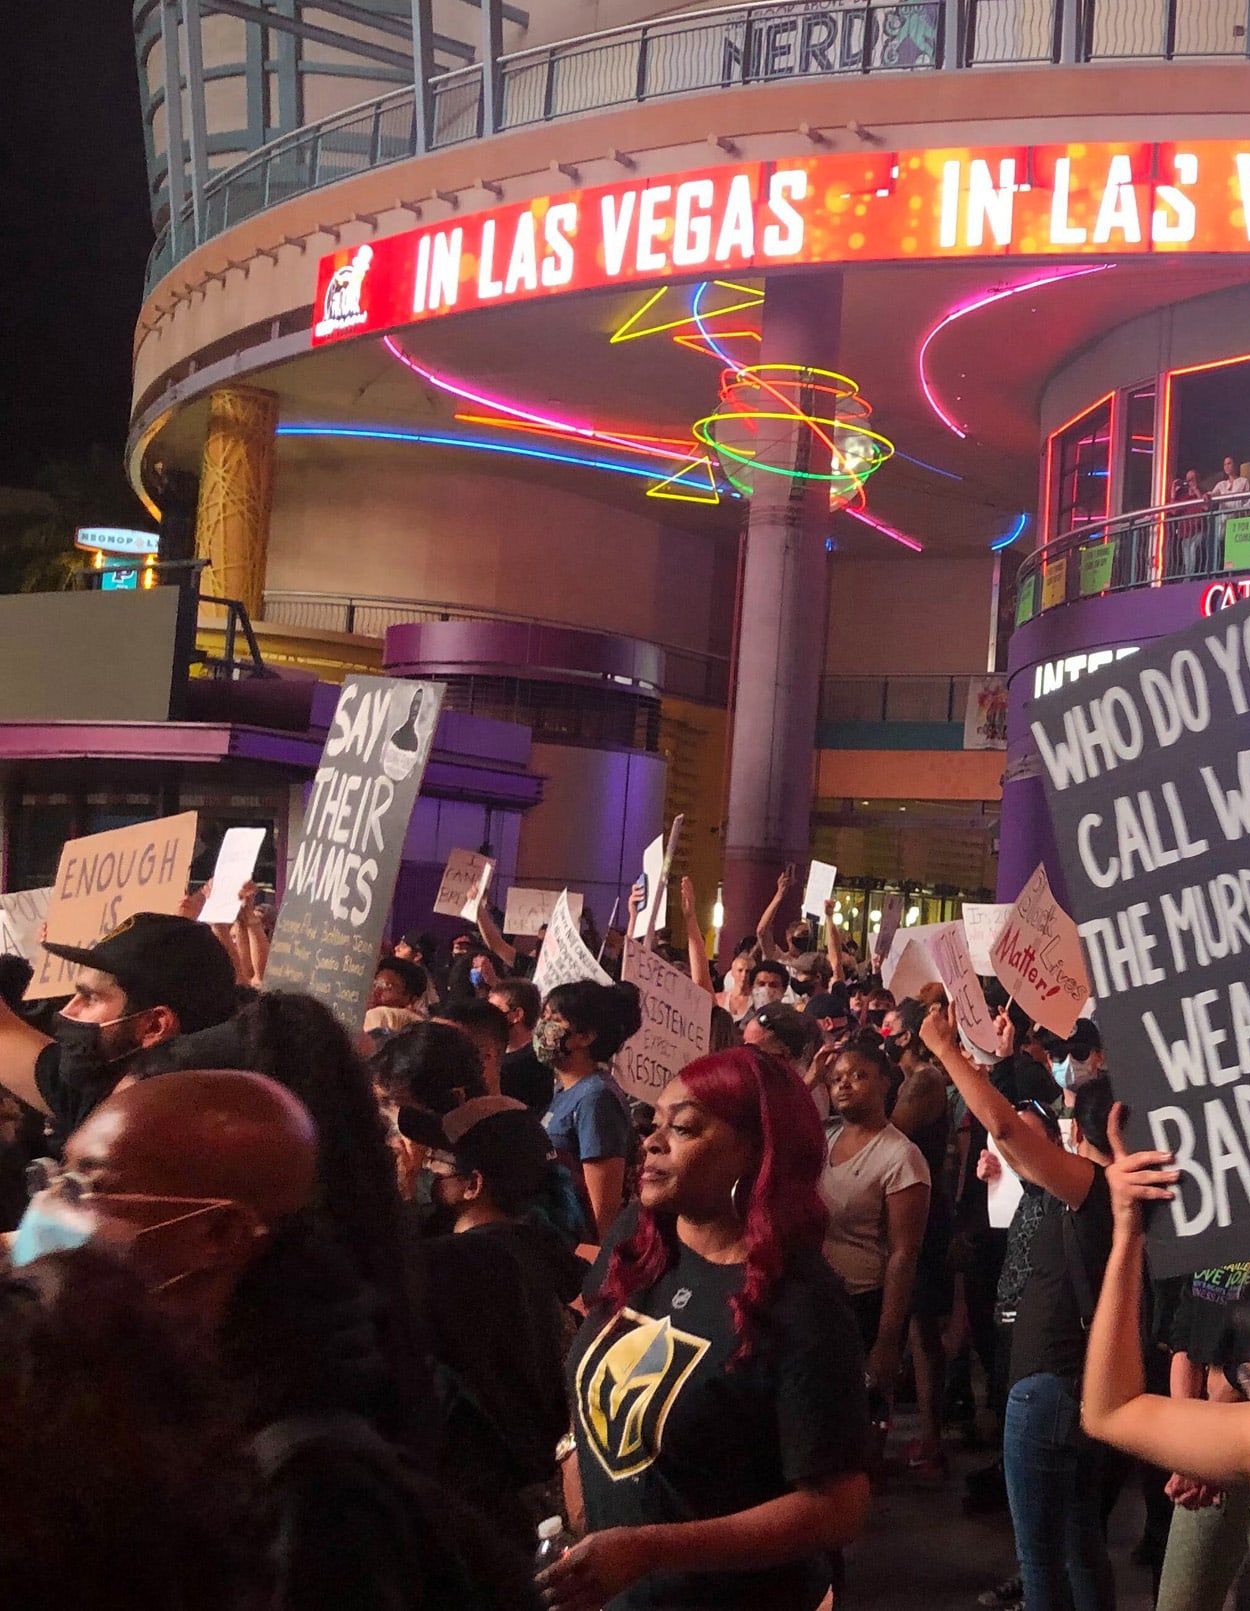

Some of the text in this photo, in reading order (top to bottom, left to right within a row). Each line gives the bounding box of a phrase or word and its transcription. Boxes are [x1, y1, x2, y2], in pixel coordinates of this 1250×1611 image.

[721, 9, 880, 88] NERD
[414, 170, 808, 312] IN LAS VEGAS
[940, 159, 1019, 247] IN
[1049, 154, 1198, 243] LAS
[326, 683, 391, 763] SAY
[1031, 686, 1142, 790] WHO
[1141, 649, 1209, 747] DO
[306, 766, 394, 853] THEIR
[1076, 796, 1208, 888] CALL
[61, 838, 179, 900] ENOUGH
[288, 840, 378, 927] NAMES
[99, 895, 122, 935] IS
[1079, 915, 1158, 997] THE
[995, 919, 1061, 1001] Matter!
[1039, 934, 1088, 1001] Lives
[640, 989, 704, 1051] XISTENCE
